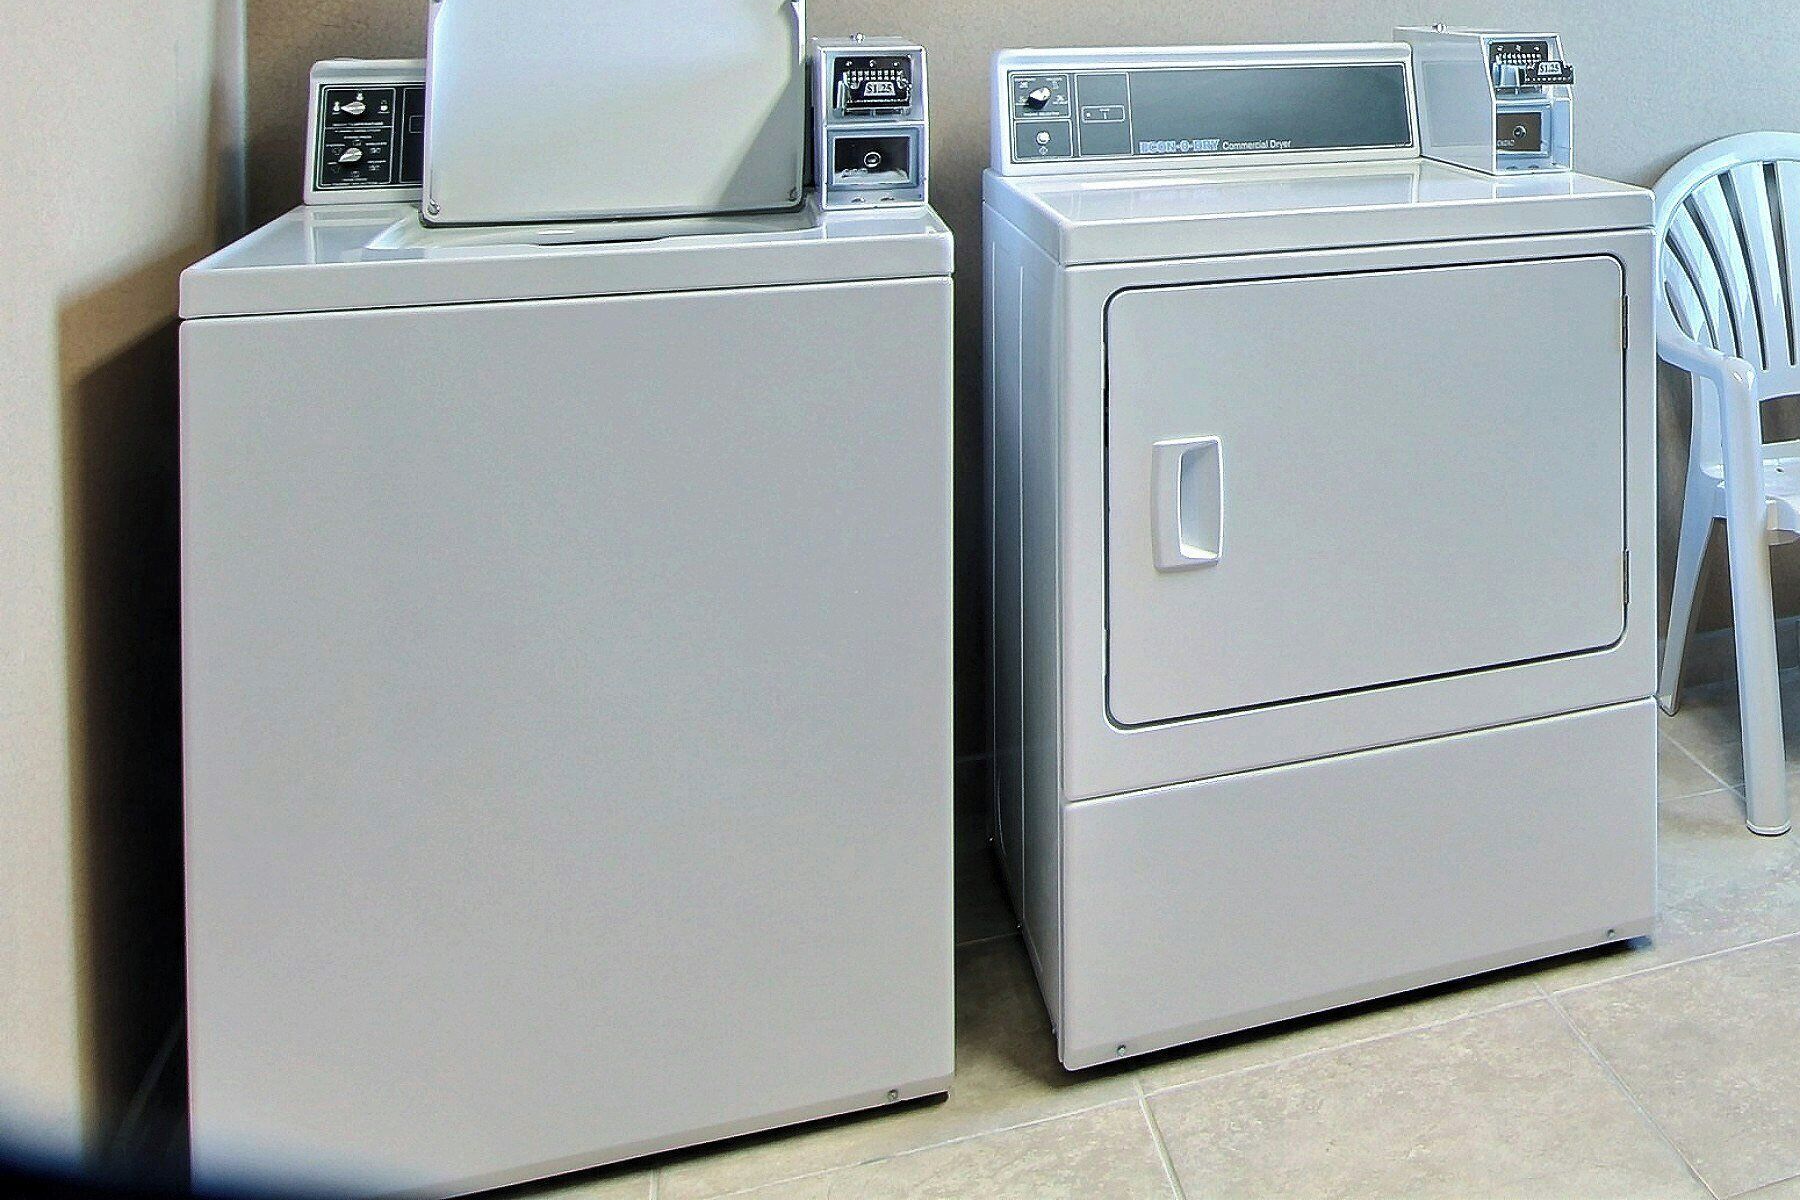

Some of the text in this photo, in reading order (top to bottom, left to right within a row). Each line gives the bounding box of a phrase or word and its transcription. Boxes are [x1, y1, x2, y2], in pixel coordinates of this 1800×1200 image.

[1540, 64, 1560, 73] $1.25
[866, 83, 892, 93] $1.25
[1222, 140, 1268, 150] Commercial
[1270, 139, 1291, 150] Dryer
